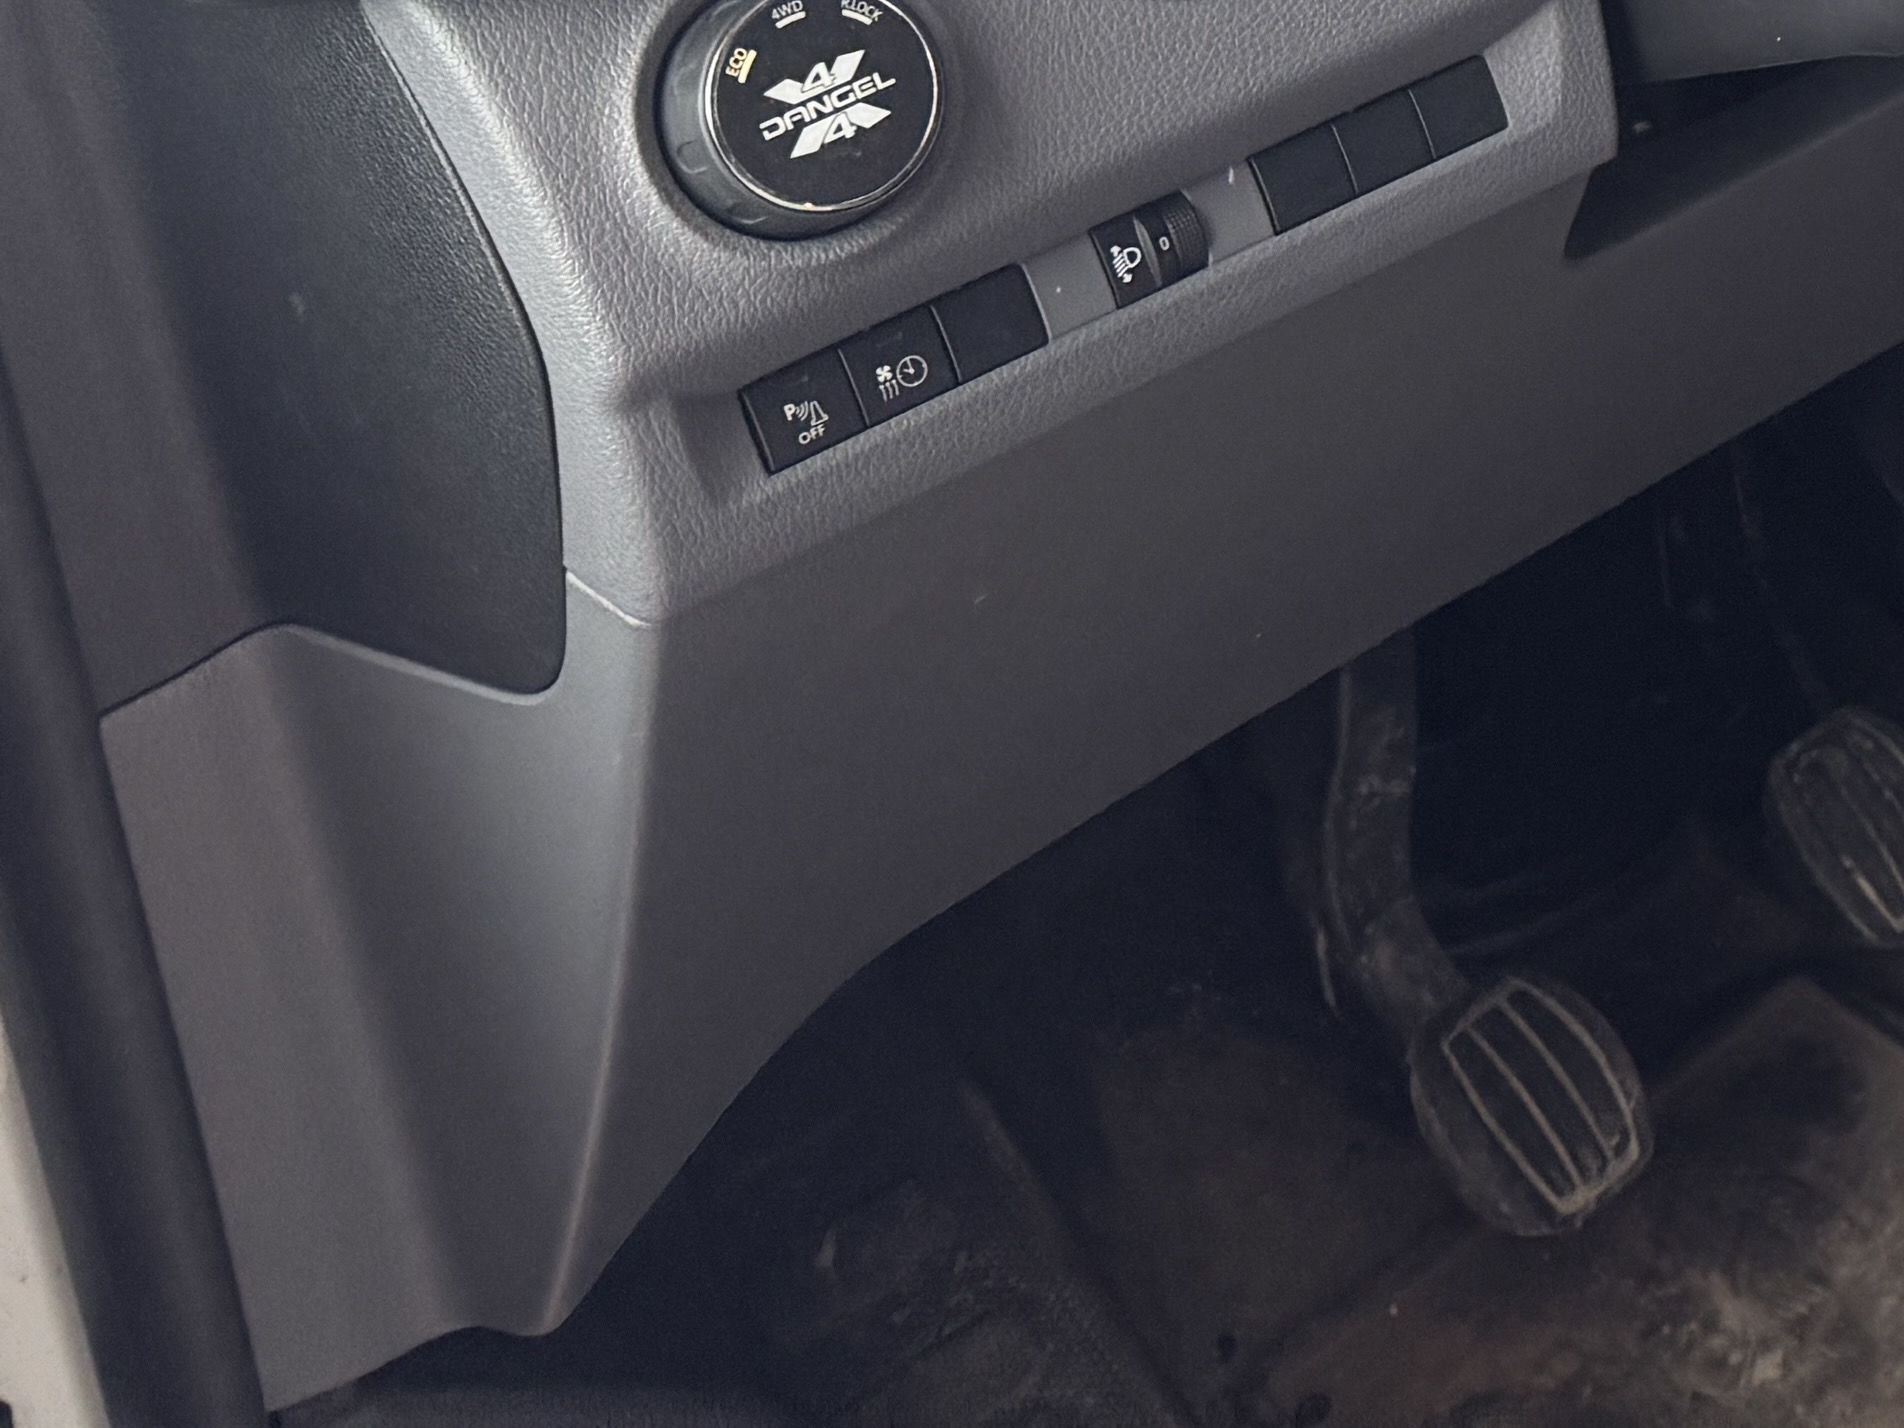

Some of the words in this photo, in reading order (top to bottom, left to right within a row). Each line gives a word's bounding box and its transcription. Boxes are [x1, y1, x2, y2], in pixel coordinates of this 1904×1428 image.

[771, 0, 804, 21] 4WD
[725, 47, 747, 78] ECO
[759, 72, 896, 141] DANGEL
[798, 425, 825, 444] OFF
